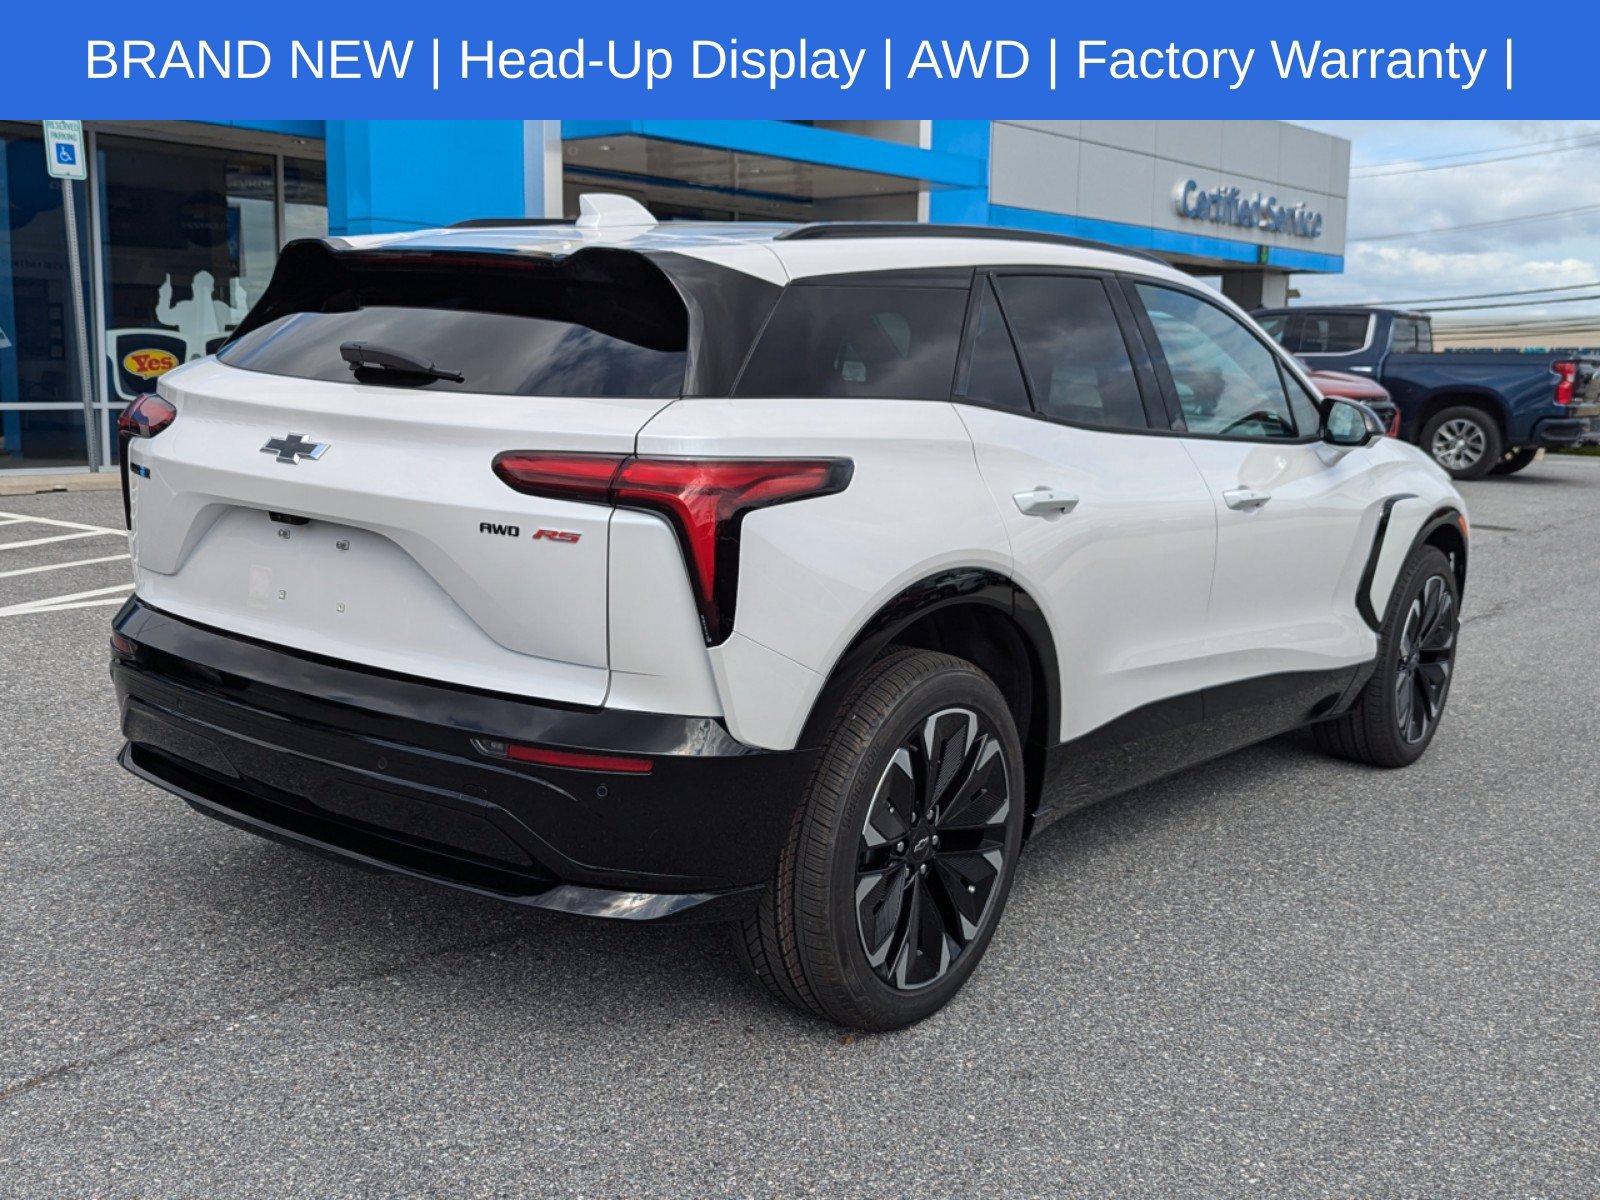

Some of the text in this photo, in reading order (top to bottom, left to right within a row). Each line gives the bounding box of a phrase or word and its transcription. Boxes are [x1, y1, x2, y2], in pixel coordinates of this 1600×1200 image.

[50, 131, 78, 141] PARKING
[1176, 179, 1322, 238] Certified Service
[132, 354, 174, 372] Yes
[480, 522, 582, 544] AWD RS
